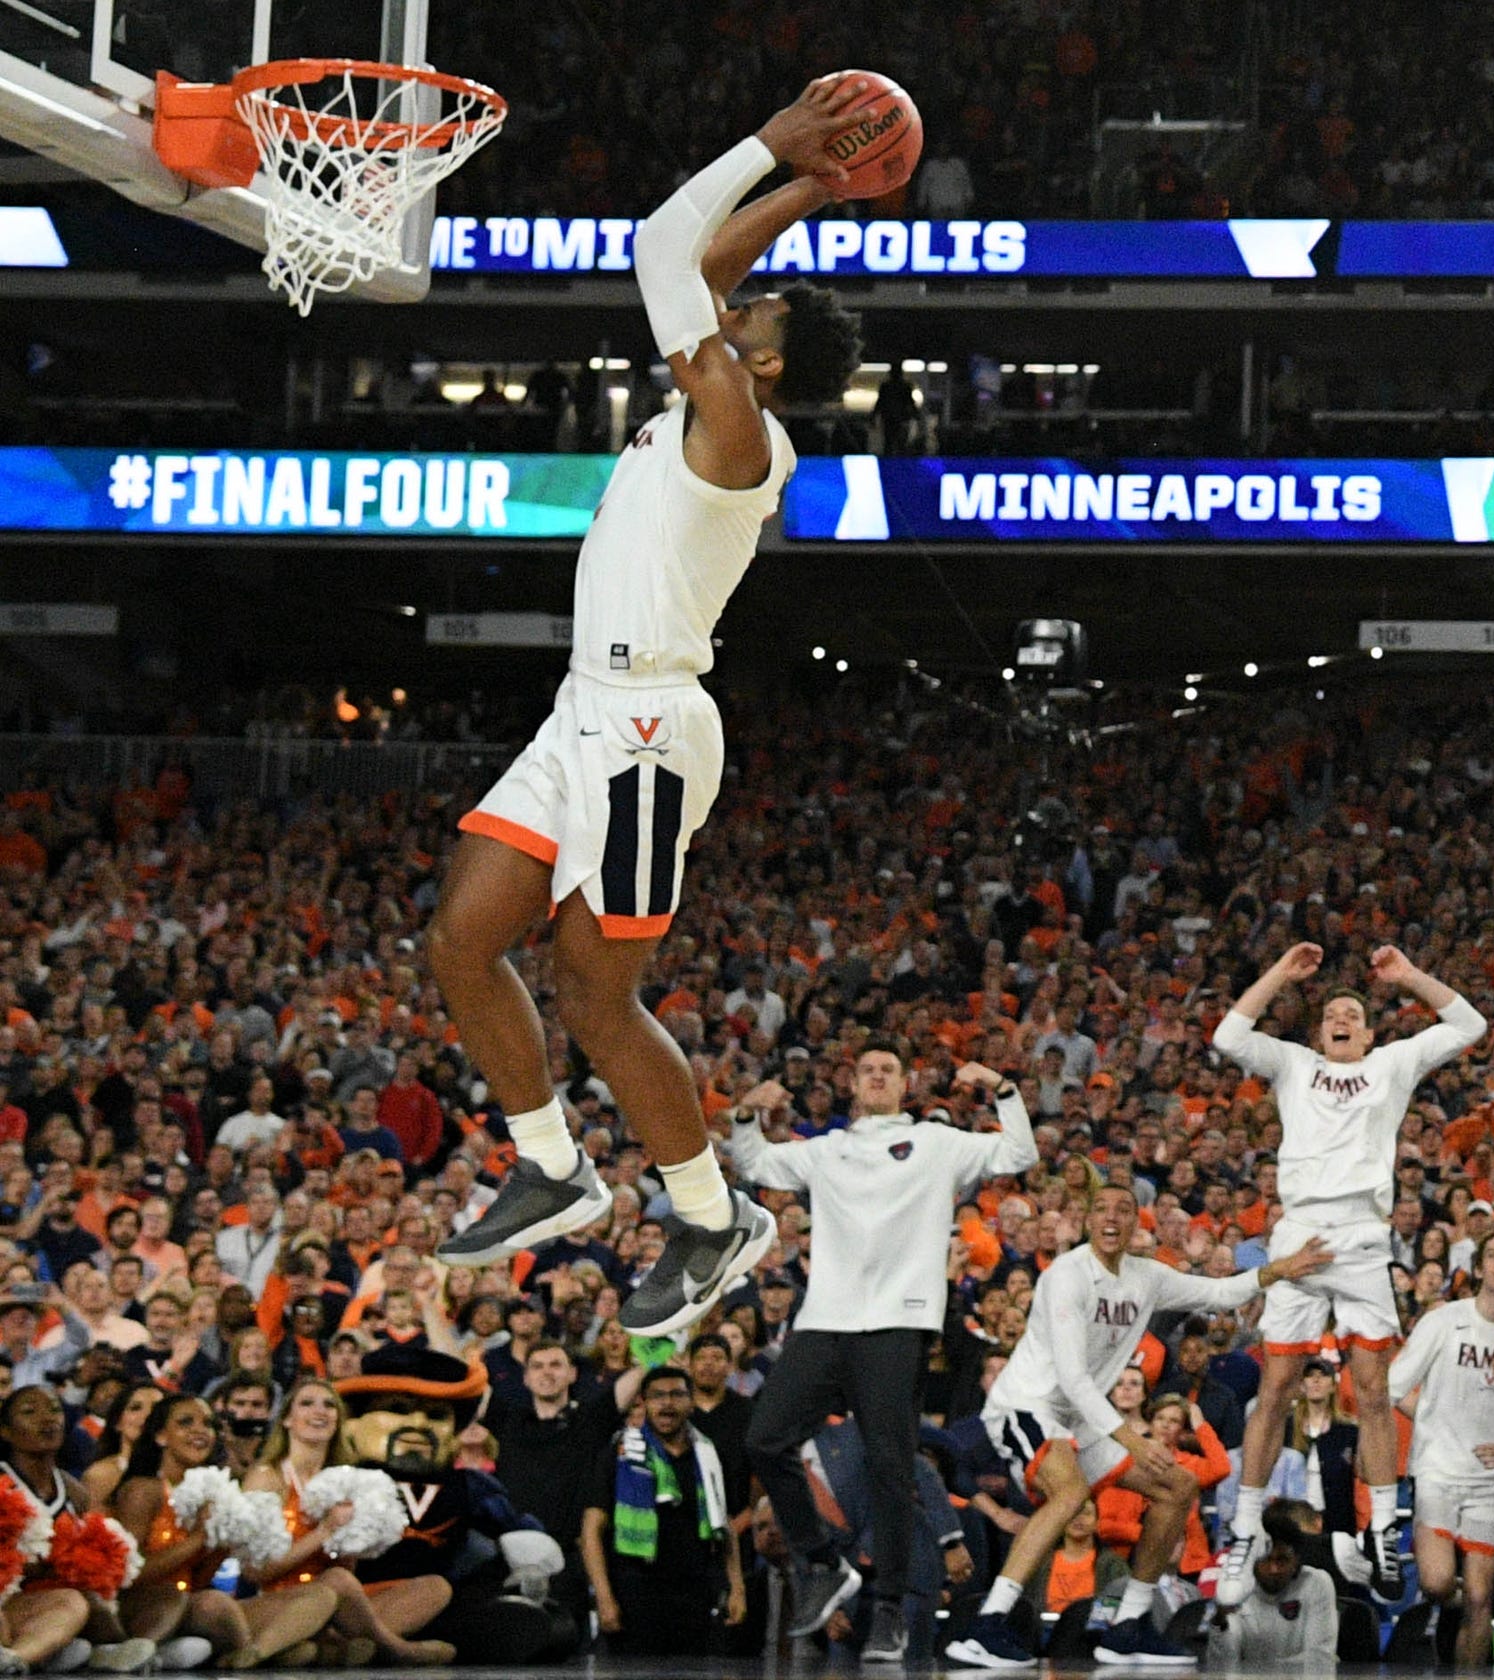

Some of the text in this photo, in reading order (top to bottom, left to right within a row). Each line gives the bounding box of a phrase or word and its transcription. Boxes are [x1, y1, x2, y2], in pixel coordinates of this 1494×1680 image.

[829, 105, 905, 161] Wilson
[485, 217, 530, 257] TO
[532, 217, 1027, 272] MIAPOLIS
[108, 454, 511, 528] #FINALFOUR
[939, 473, 1382, 521] MINNEAPOLIS
[1375, 626, 1412, 645] 106
